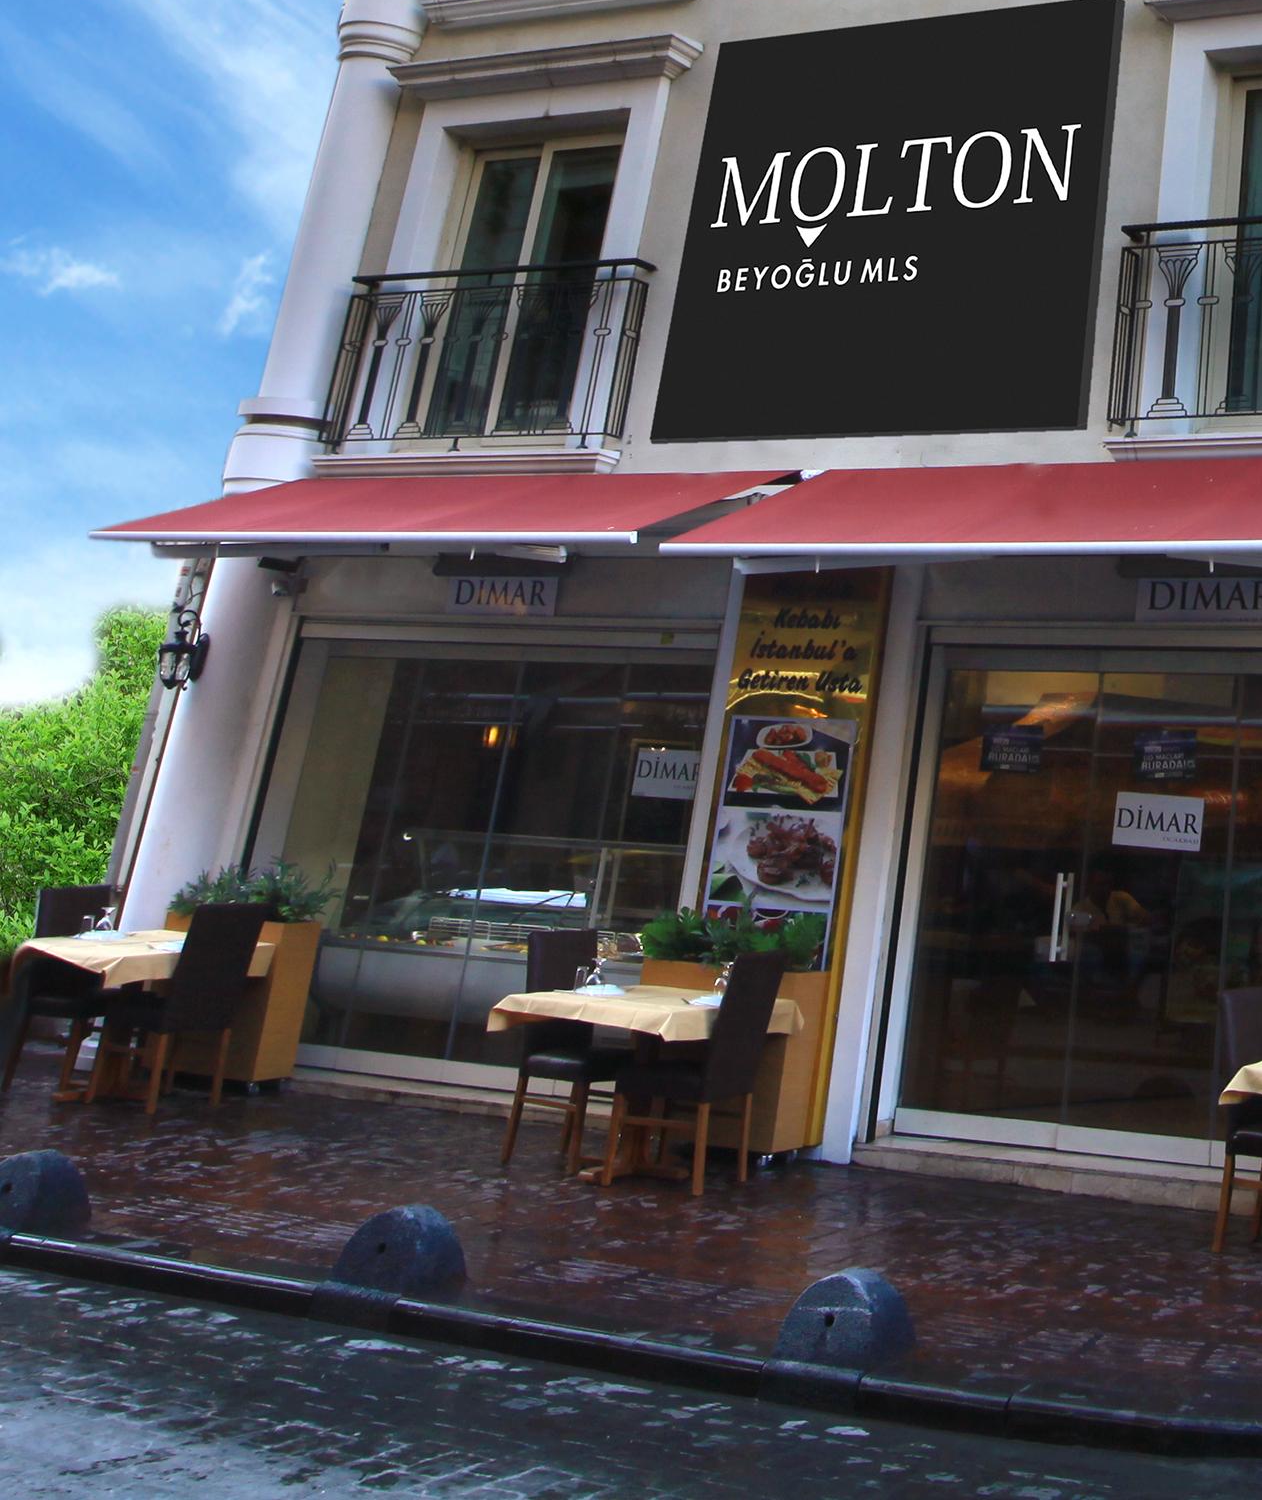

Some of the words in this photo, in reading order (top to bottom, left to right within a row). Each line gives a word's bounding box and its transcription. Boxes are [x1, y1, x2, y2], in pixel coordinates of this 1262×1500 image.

[710, 123, 1082, 229] MOLTON
[860, 255, 919, 284] MLS
[737, 667, 810, 692] Getiren
[814, 671, 863, 695] Usta
[1116, 804, 1199, 835] DİMAR
